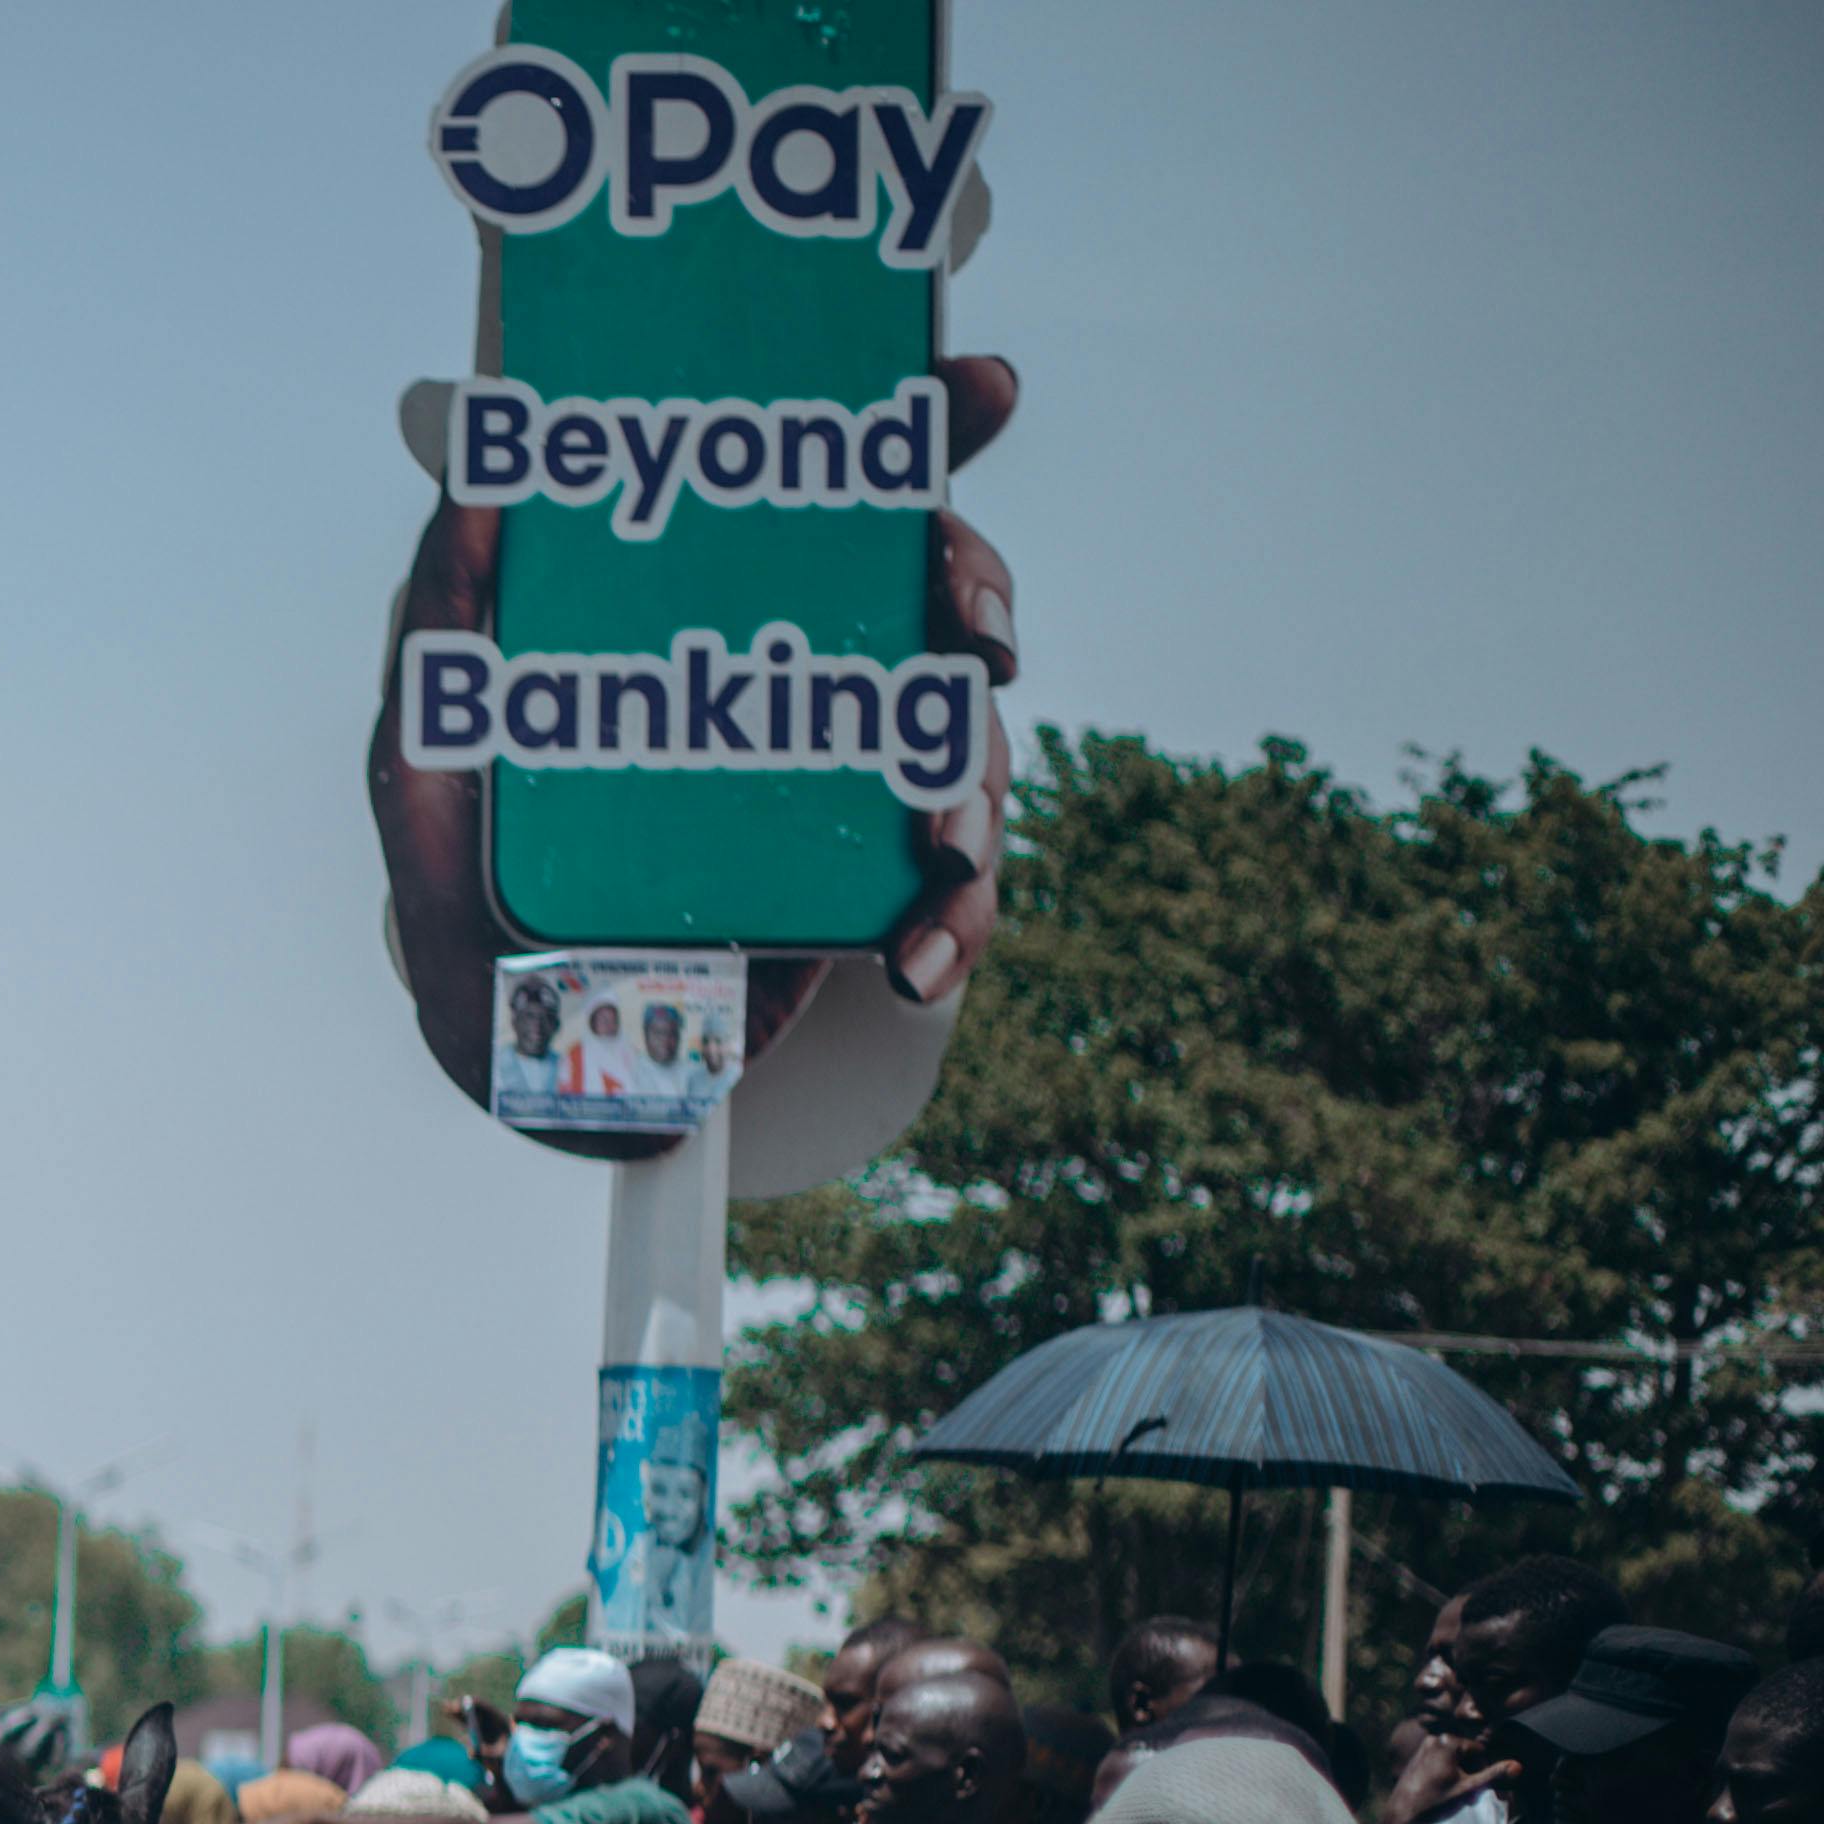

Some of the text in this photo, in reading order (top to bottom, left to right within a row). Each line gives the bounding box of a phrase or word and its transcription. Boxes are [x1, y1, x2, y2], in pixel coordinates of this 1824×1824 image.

[441, 62, 984, 252] OPay
[465, 394, 931, 523] Beyond
[420, 640, 972, 790] Banking
